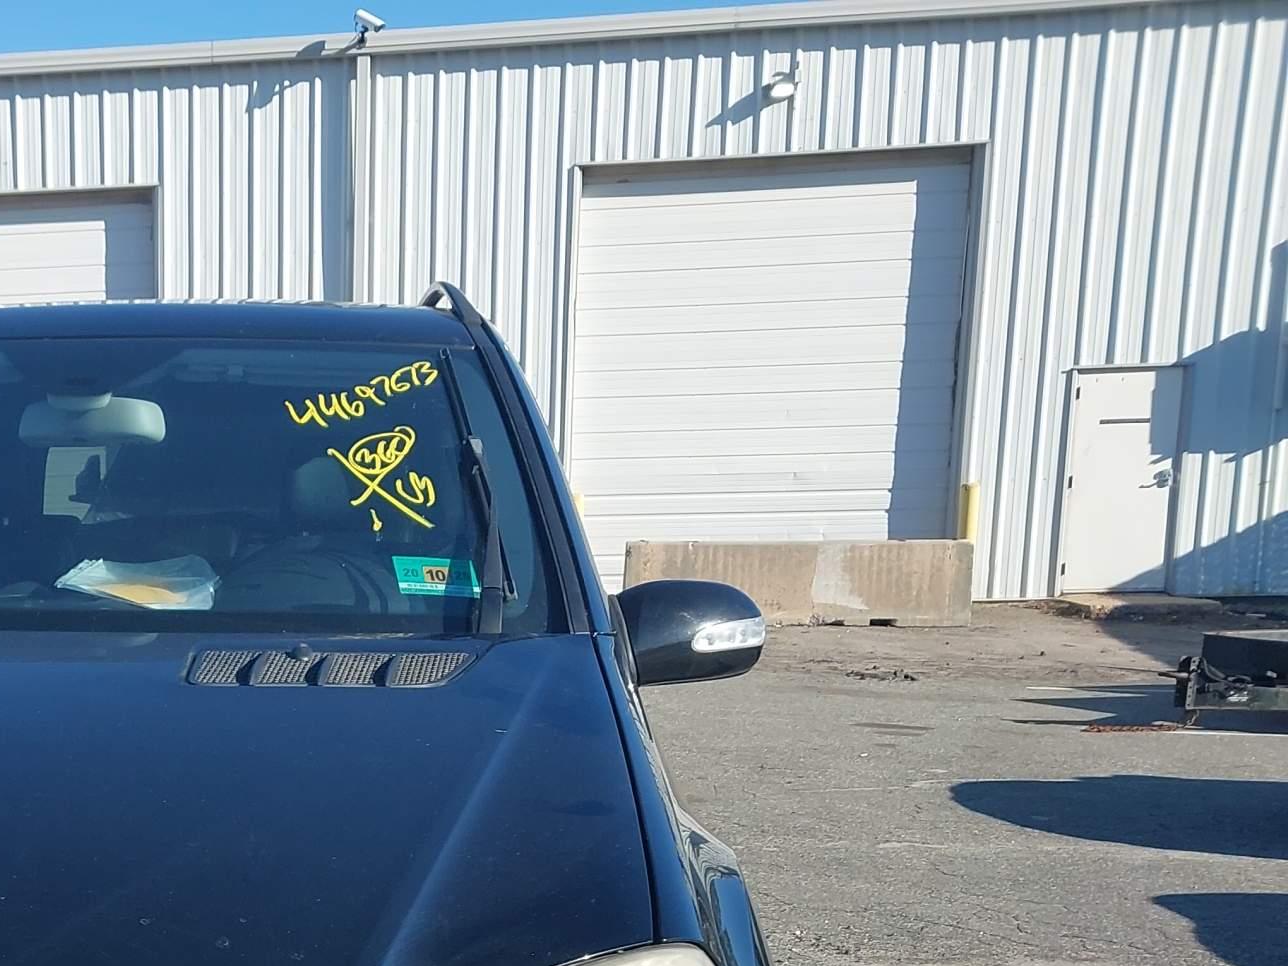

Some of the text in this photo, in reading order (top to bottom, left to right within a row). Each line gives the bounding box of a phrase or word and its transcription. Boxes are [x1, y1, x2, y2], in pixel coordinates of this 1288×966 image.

[284, 361, 438, 428] 44697673
[402, 567, 419, 578] 20
[425, 568, 446, 582] 10
